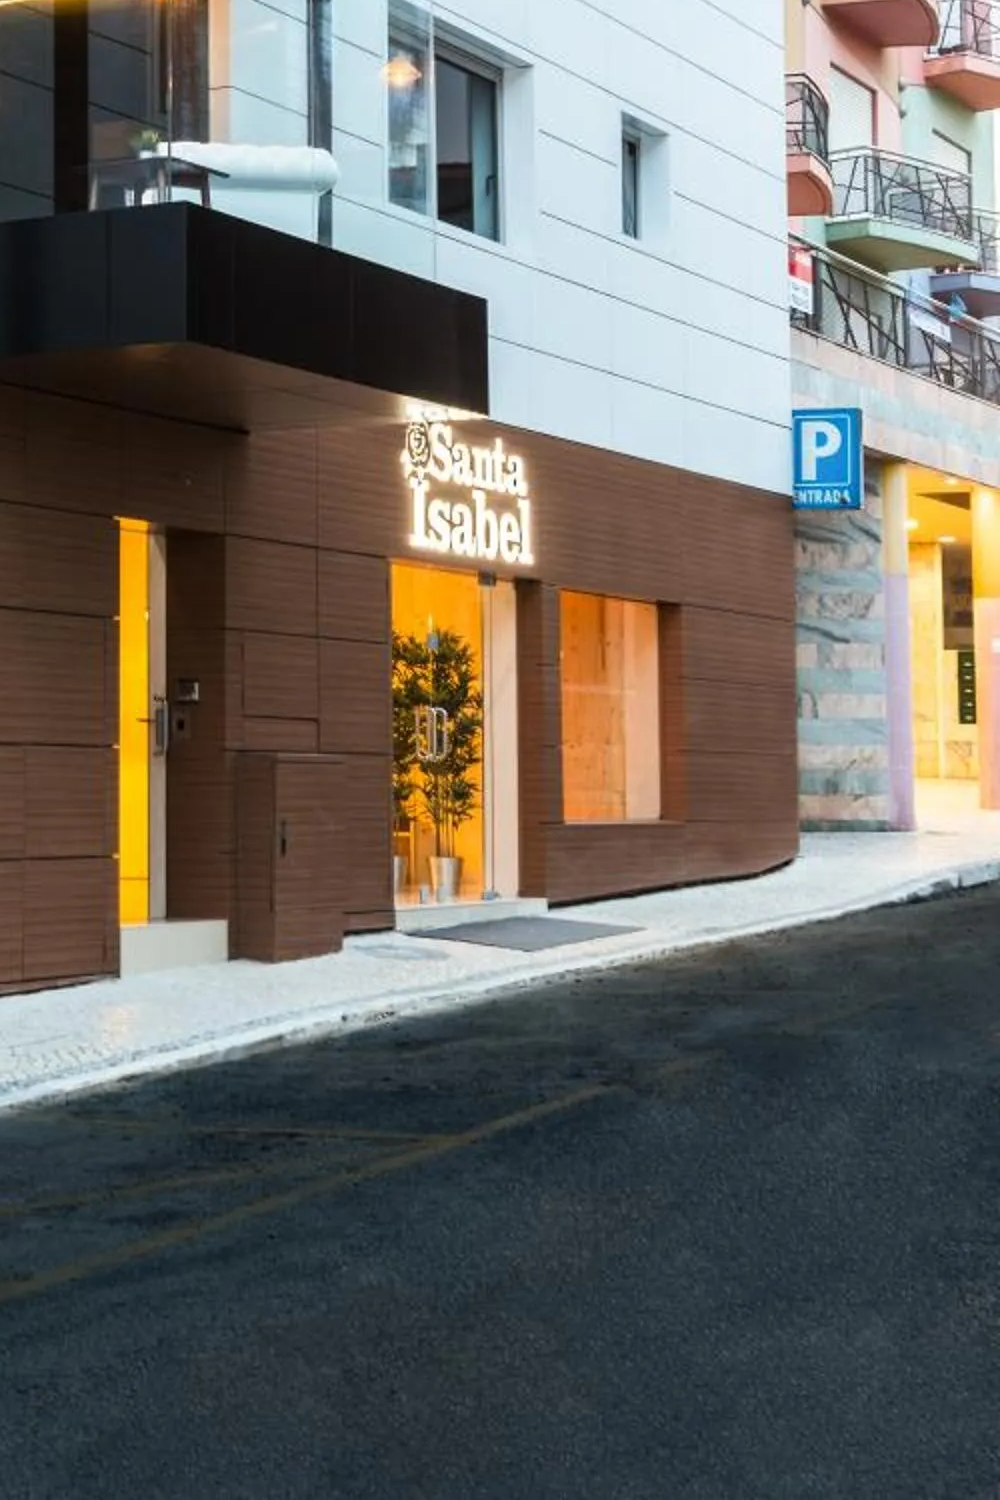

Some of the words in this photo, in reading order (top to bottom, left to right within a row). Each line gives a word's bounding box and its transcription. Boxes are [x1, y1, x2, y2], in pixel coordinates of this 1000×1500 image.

[429, 422, 528, 498] Santa
[801, 420, 842, 480] P
[408, 480, 535, 566] Isabel
